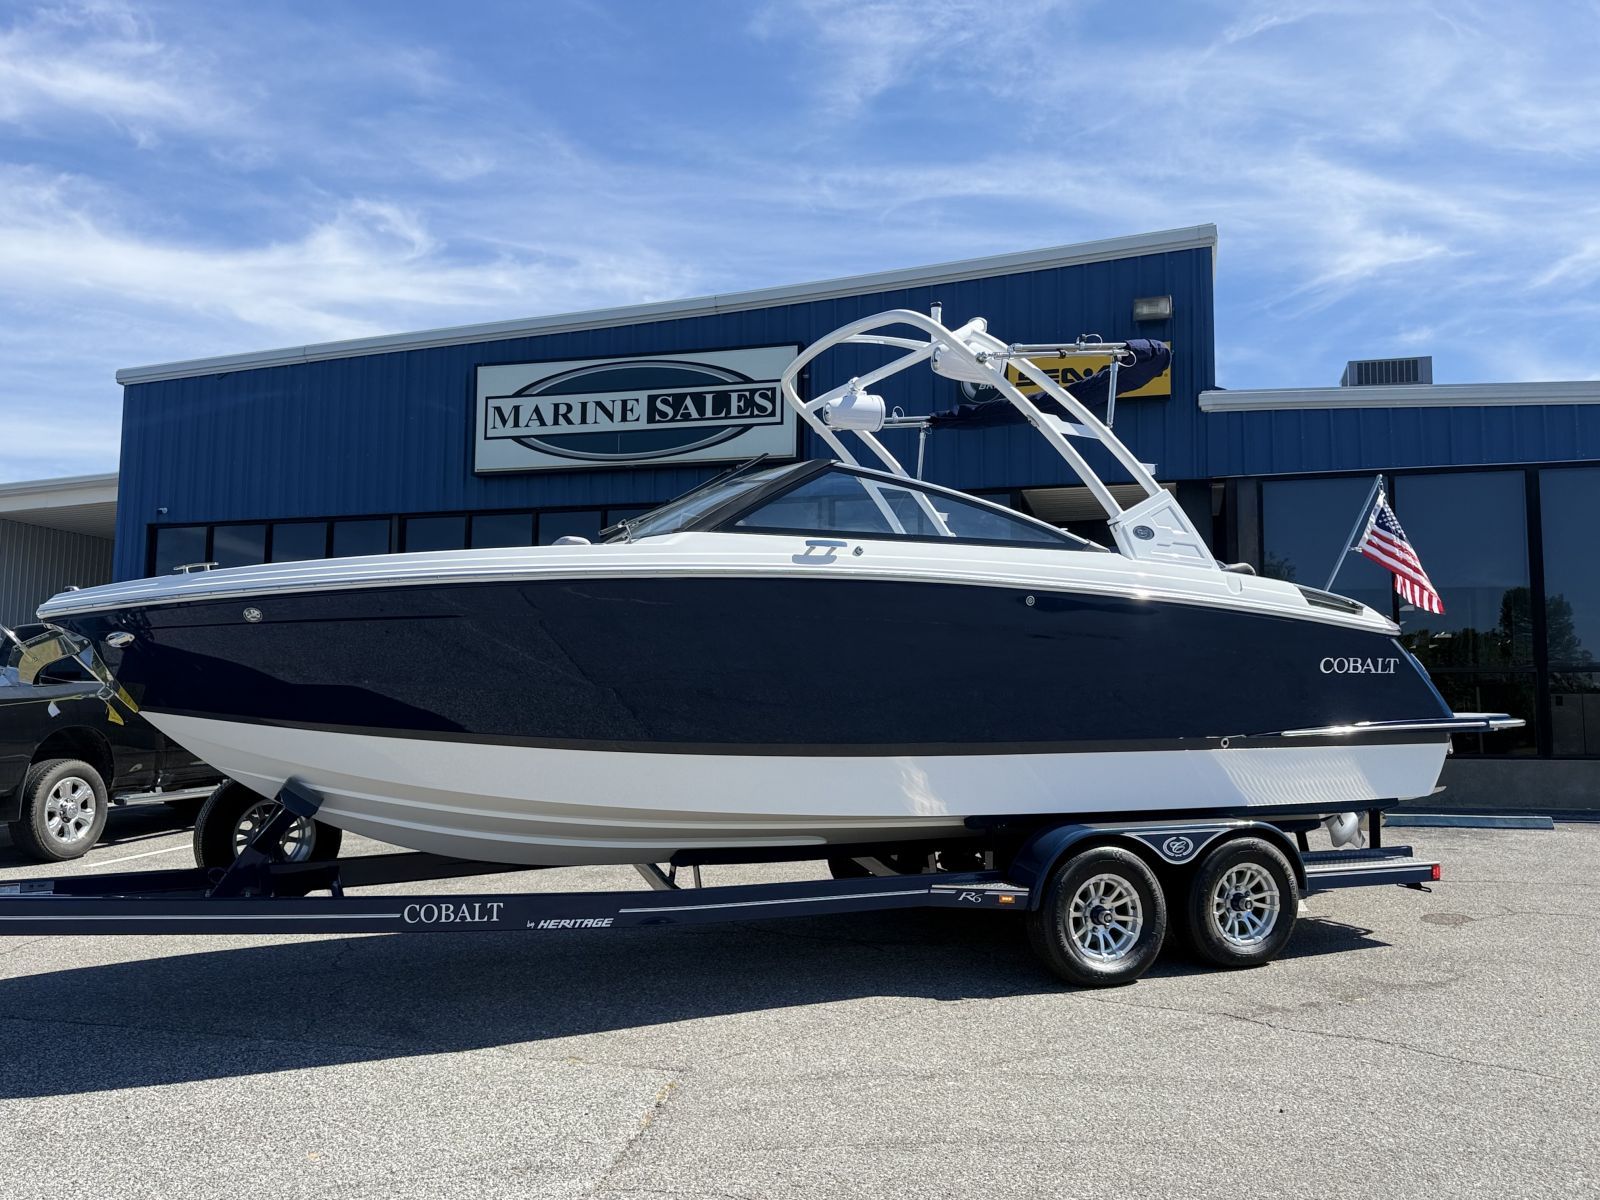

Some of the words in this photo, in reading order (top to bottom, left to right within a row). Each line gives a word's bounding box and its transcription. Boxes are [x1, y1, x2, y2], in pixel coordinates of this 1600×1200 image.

[489, 398, 641, 430] MARINE
[654, 389, 774, 422] SALES
[1319, 657, 1399, 674] COBALT
[957, 891, 984, 903] R6
[403, 902, 504, 924] COBALT
[537, 917, 615, 930] HERITAGE
